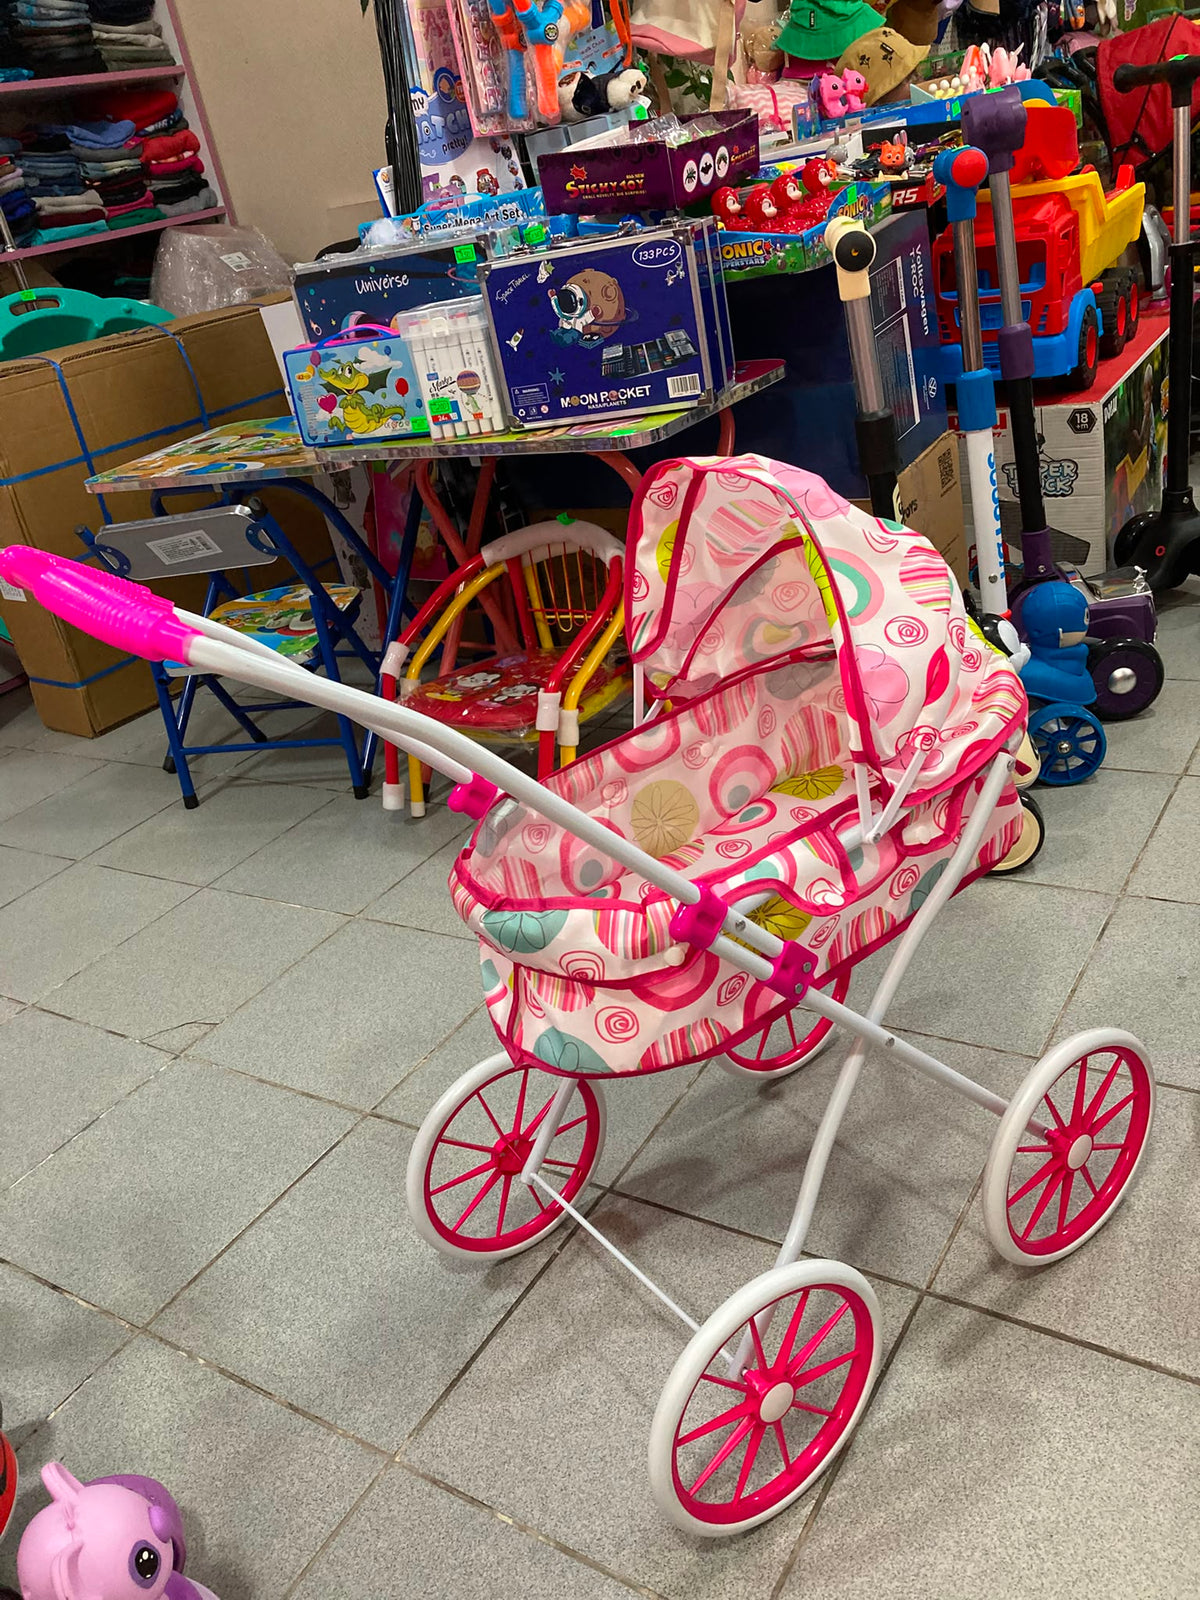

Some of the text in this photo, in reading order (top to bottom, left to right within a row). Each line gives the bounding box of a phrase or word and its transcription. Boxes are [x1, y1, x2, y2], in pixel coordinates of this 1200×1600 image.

[415, 108, 471, 146] ATCH
[565, 179, 644, 199] STICKY TOY
[638, 244, 676, 261] 133PCS
[721, 239, 764, 260] ONIC
[909, 247, 920, 299] T-ROC
[915, 243, 930, 337] Volkswagen
[1075, 412, 1089, 424] 18
[1003, 461, 1078, 481] TPER
[1010, 479, 1073, 497] TCK
